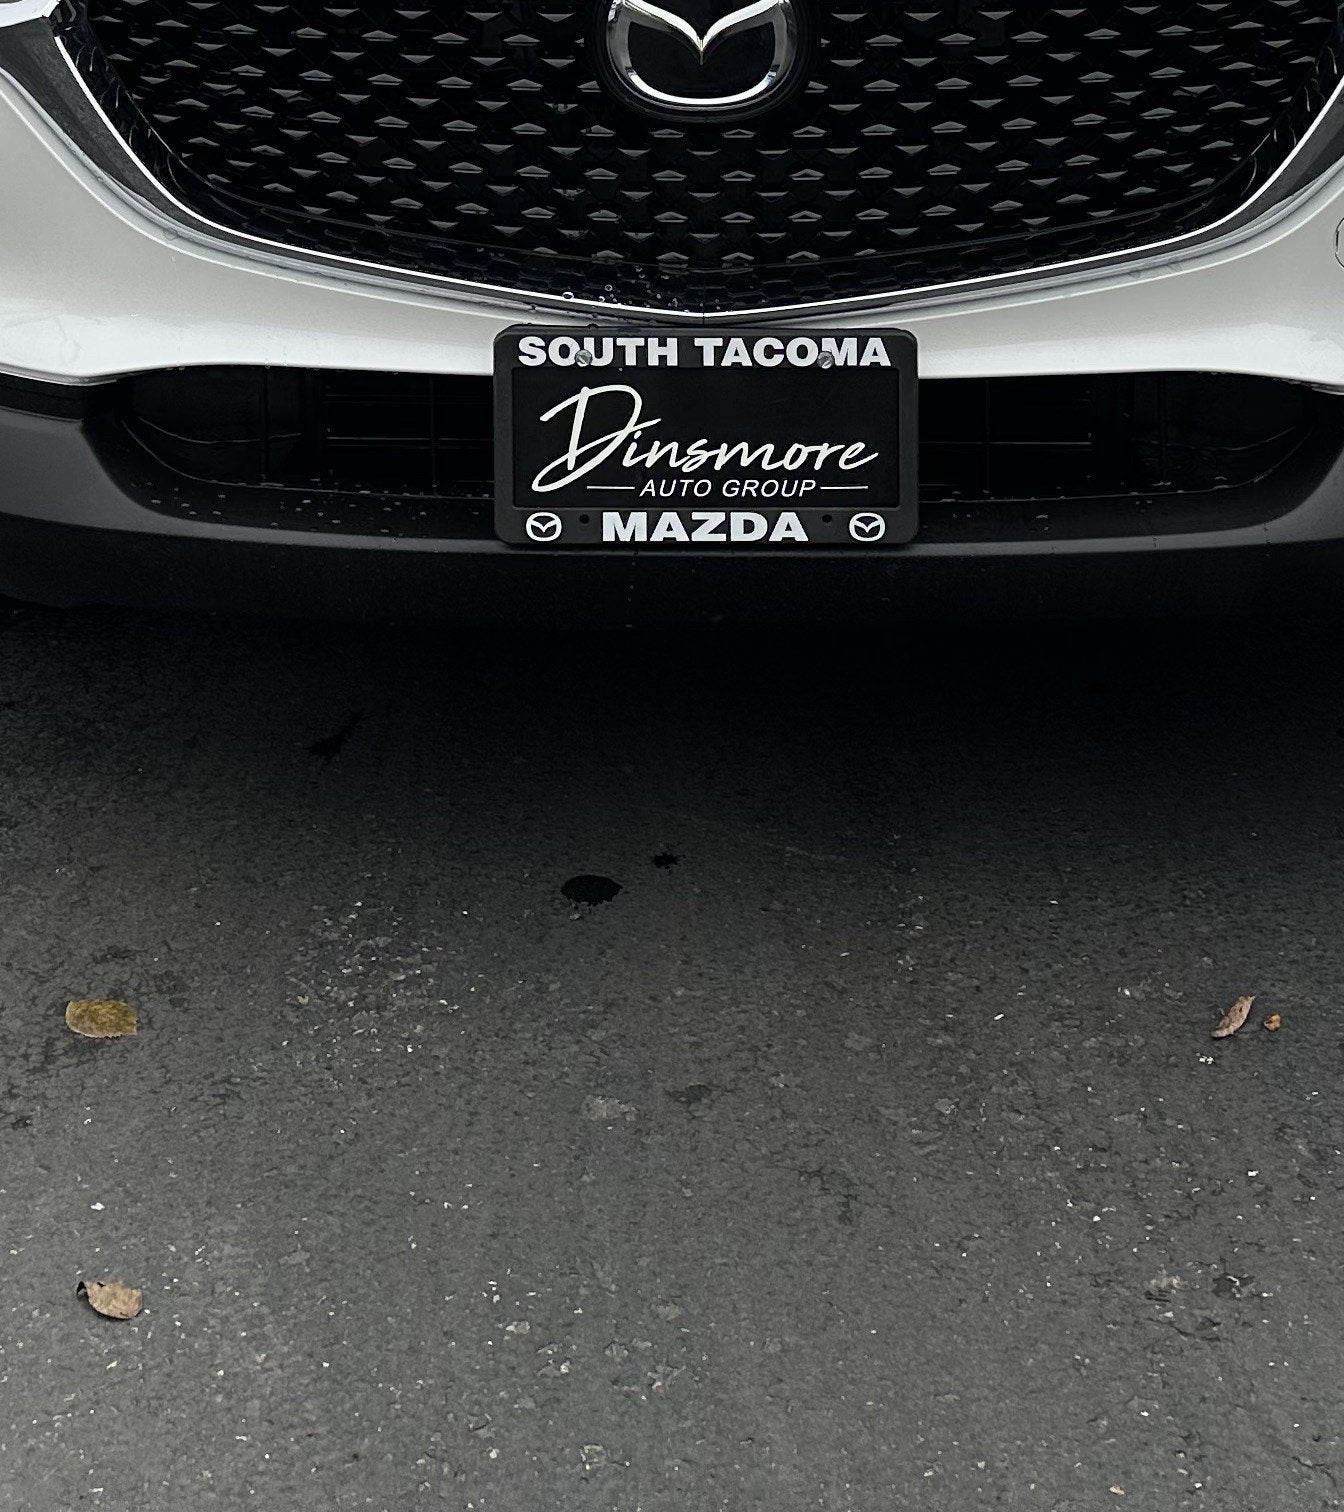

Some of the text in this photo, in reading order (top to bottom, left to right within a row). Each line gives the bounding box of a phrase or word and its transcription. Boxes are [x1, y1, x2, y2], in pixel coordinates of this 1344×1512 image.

[518, 337, 892, 367] SOUTH TACOMA
[531, 384, 878, 492] Dinsmore
[640, 479, 816, 497] AUTO GROUP
[602, 511, 809, 541] MAZDA
